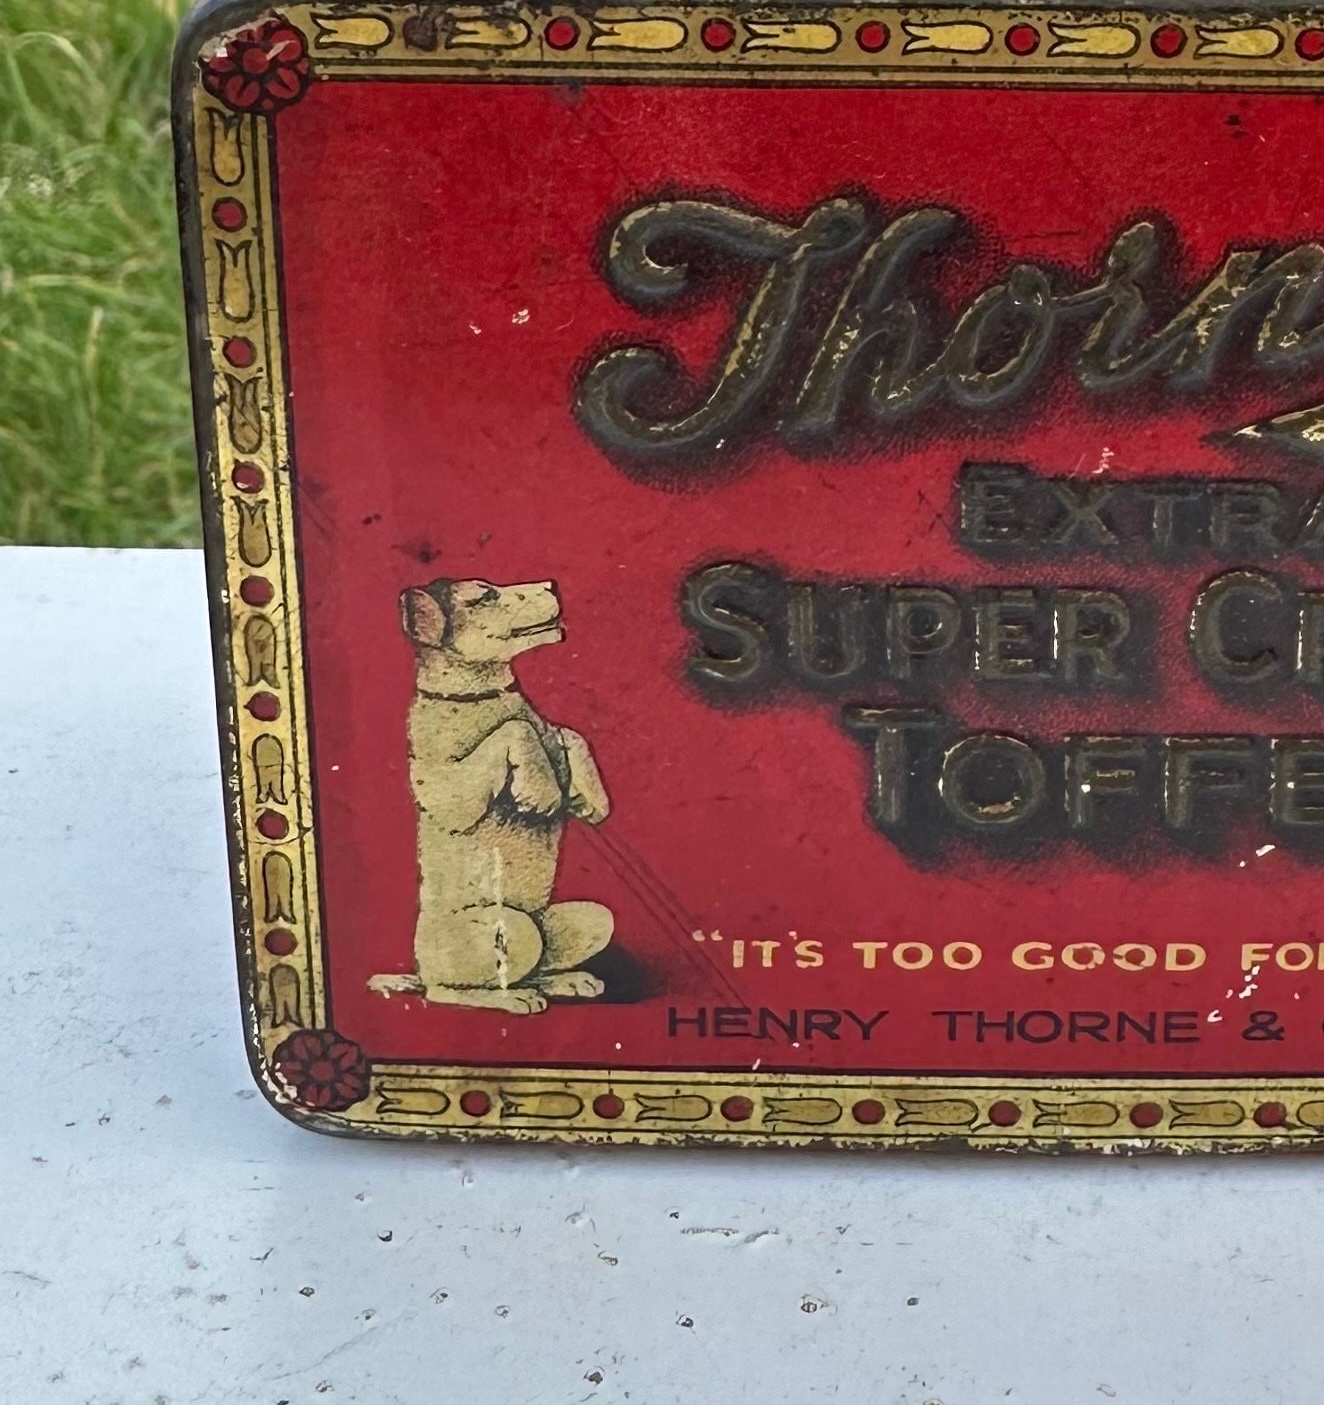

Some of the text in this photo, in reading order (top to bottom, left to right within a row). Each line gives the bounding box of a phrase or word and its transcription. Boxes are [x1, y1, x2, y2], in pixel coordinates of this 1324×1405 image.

[682, 561, 1134, 688] SUPER
[853, 941, 983, 971] TOO
[1011, 941, 1206, 972] GOOD
[667, 1006, 890, 1042] HENRY
[932, 1009, 1201, 1044] THORNE
[1241, 1009, 1286, 1042] &
